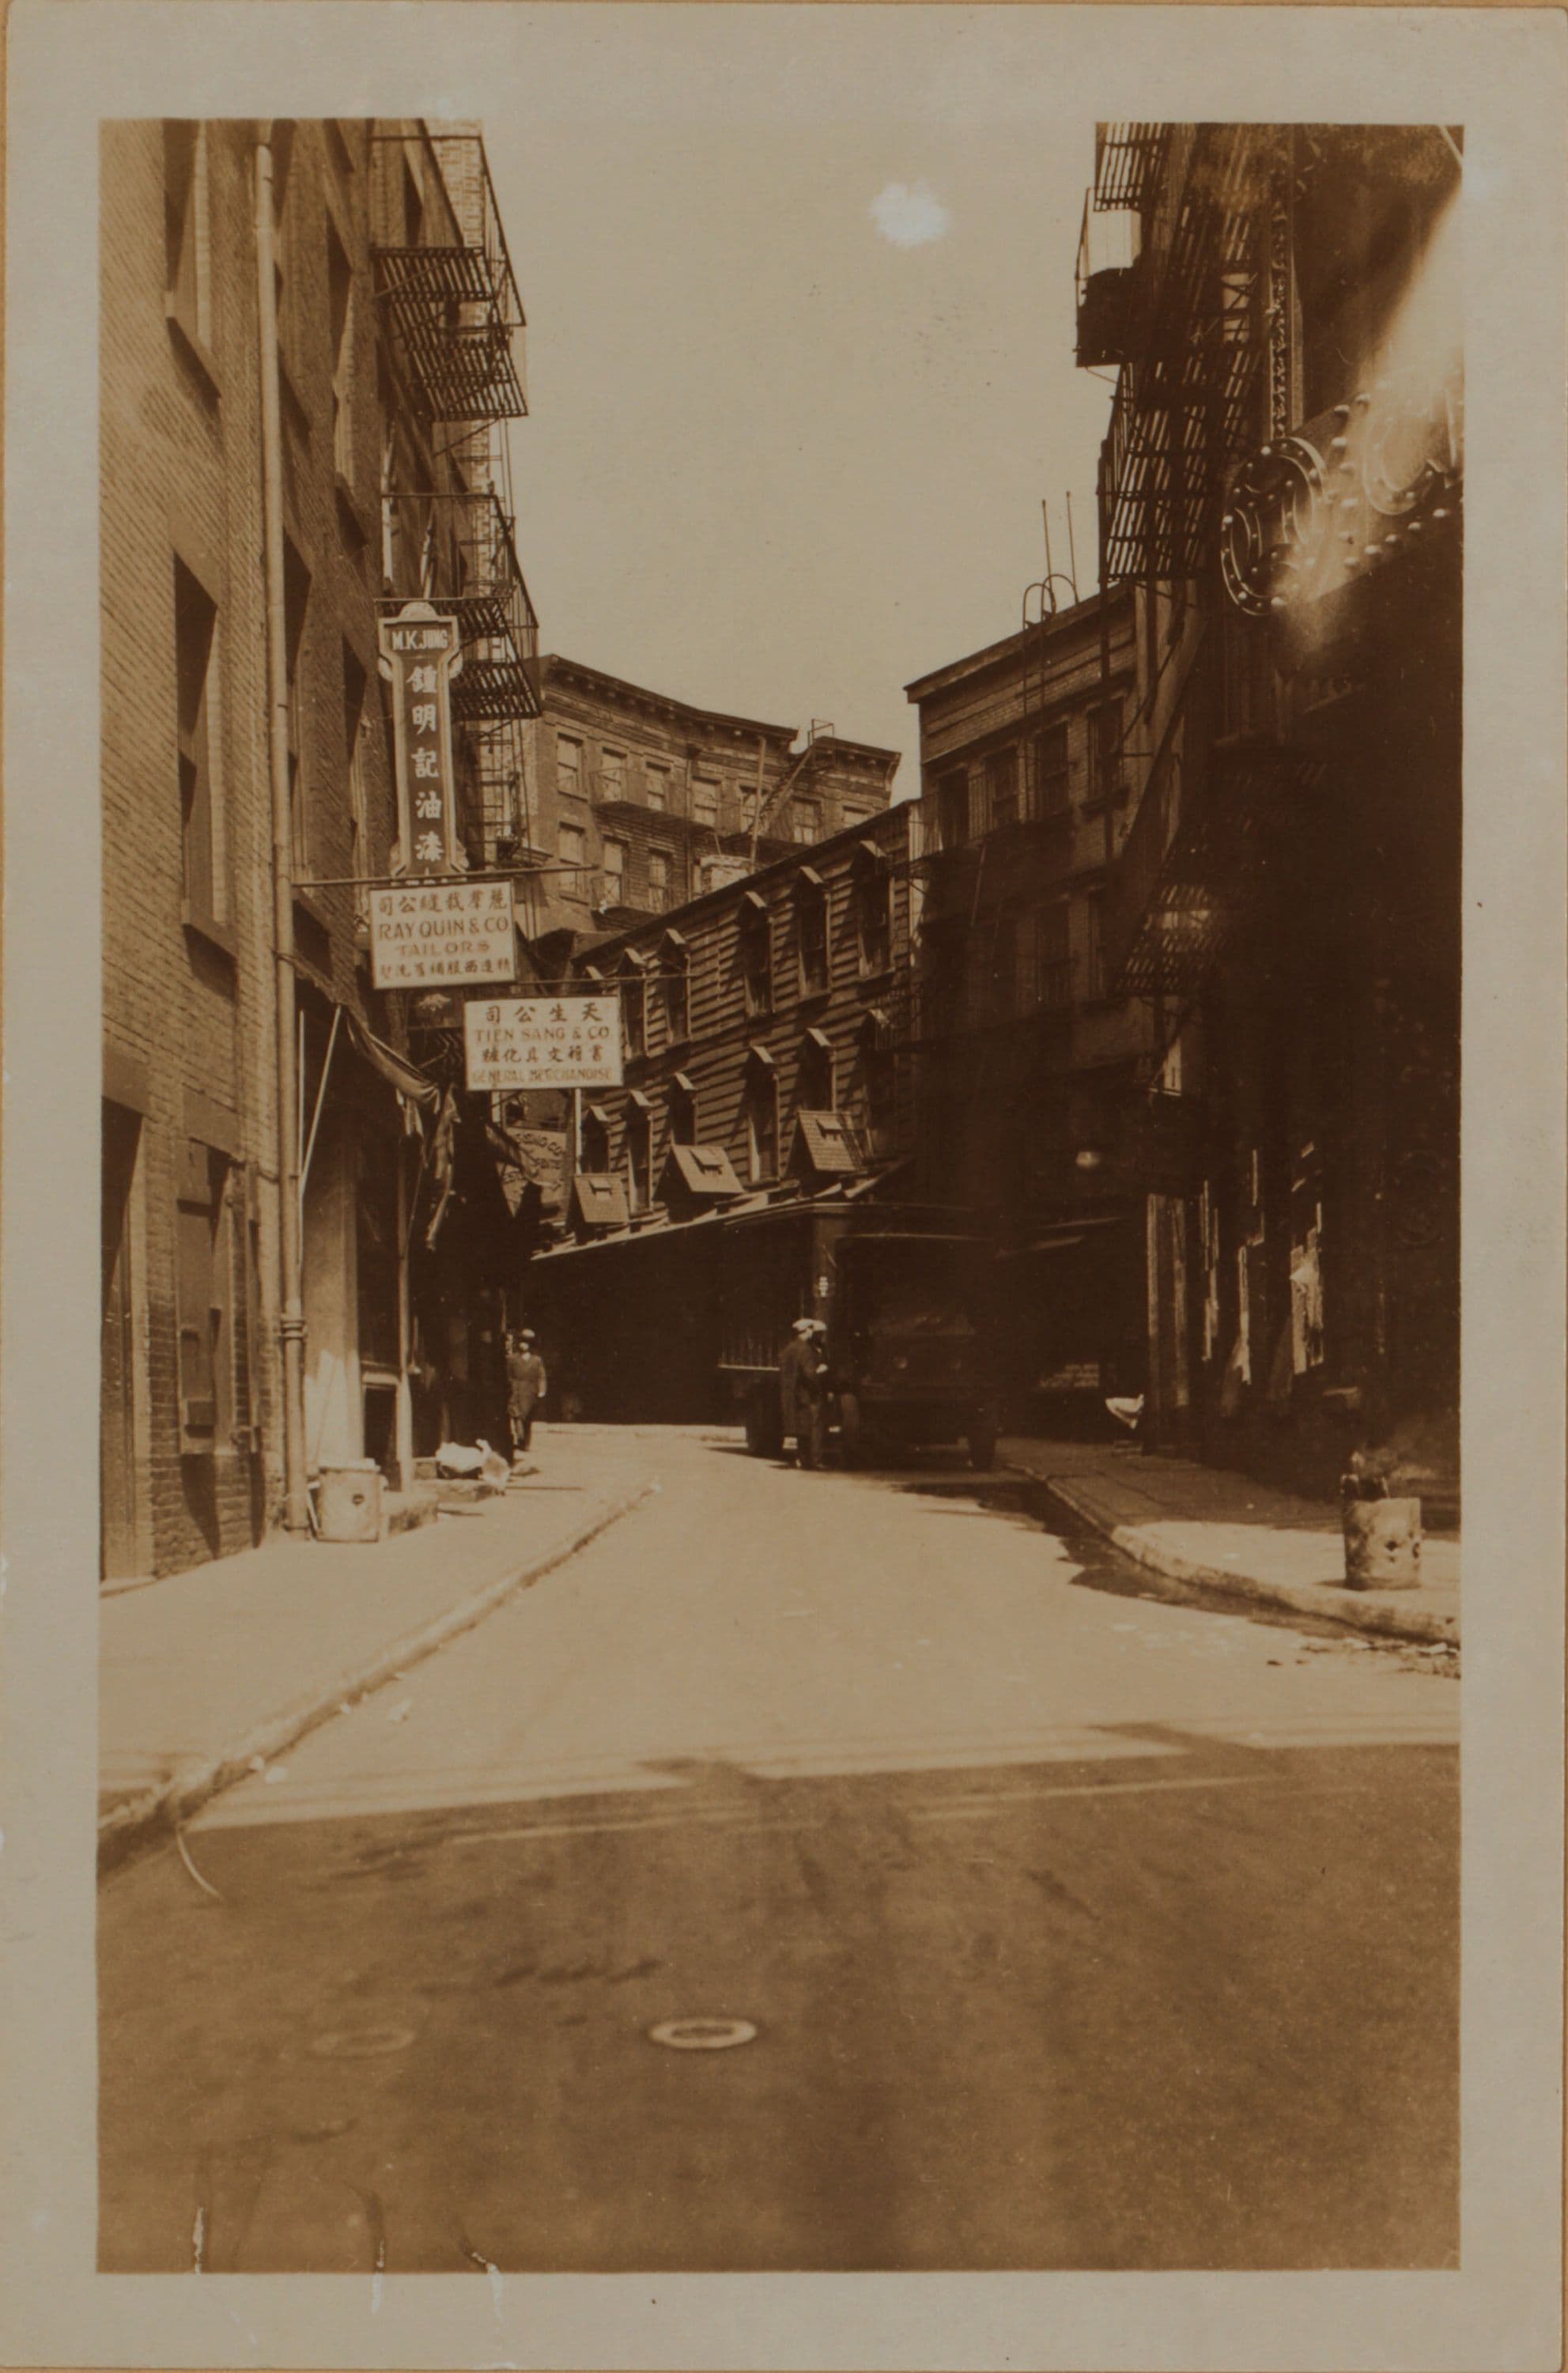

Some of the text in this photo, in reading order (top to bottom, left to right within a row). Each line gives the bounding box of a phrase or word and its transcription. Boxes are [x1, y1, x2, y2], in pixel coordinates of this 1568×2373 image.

[379, 916, 508, 940] RAY QUIN & CO
[396, 940, 490, 957] TAILORS
[475, 1026, 610, 1042] TIEN SANG & CO
[473, 1068, 524, 1083] GENERAL
